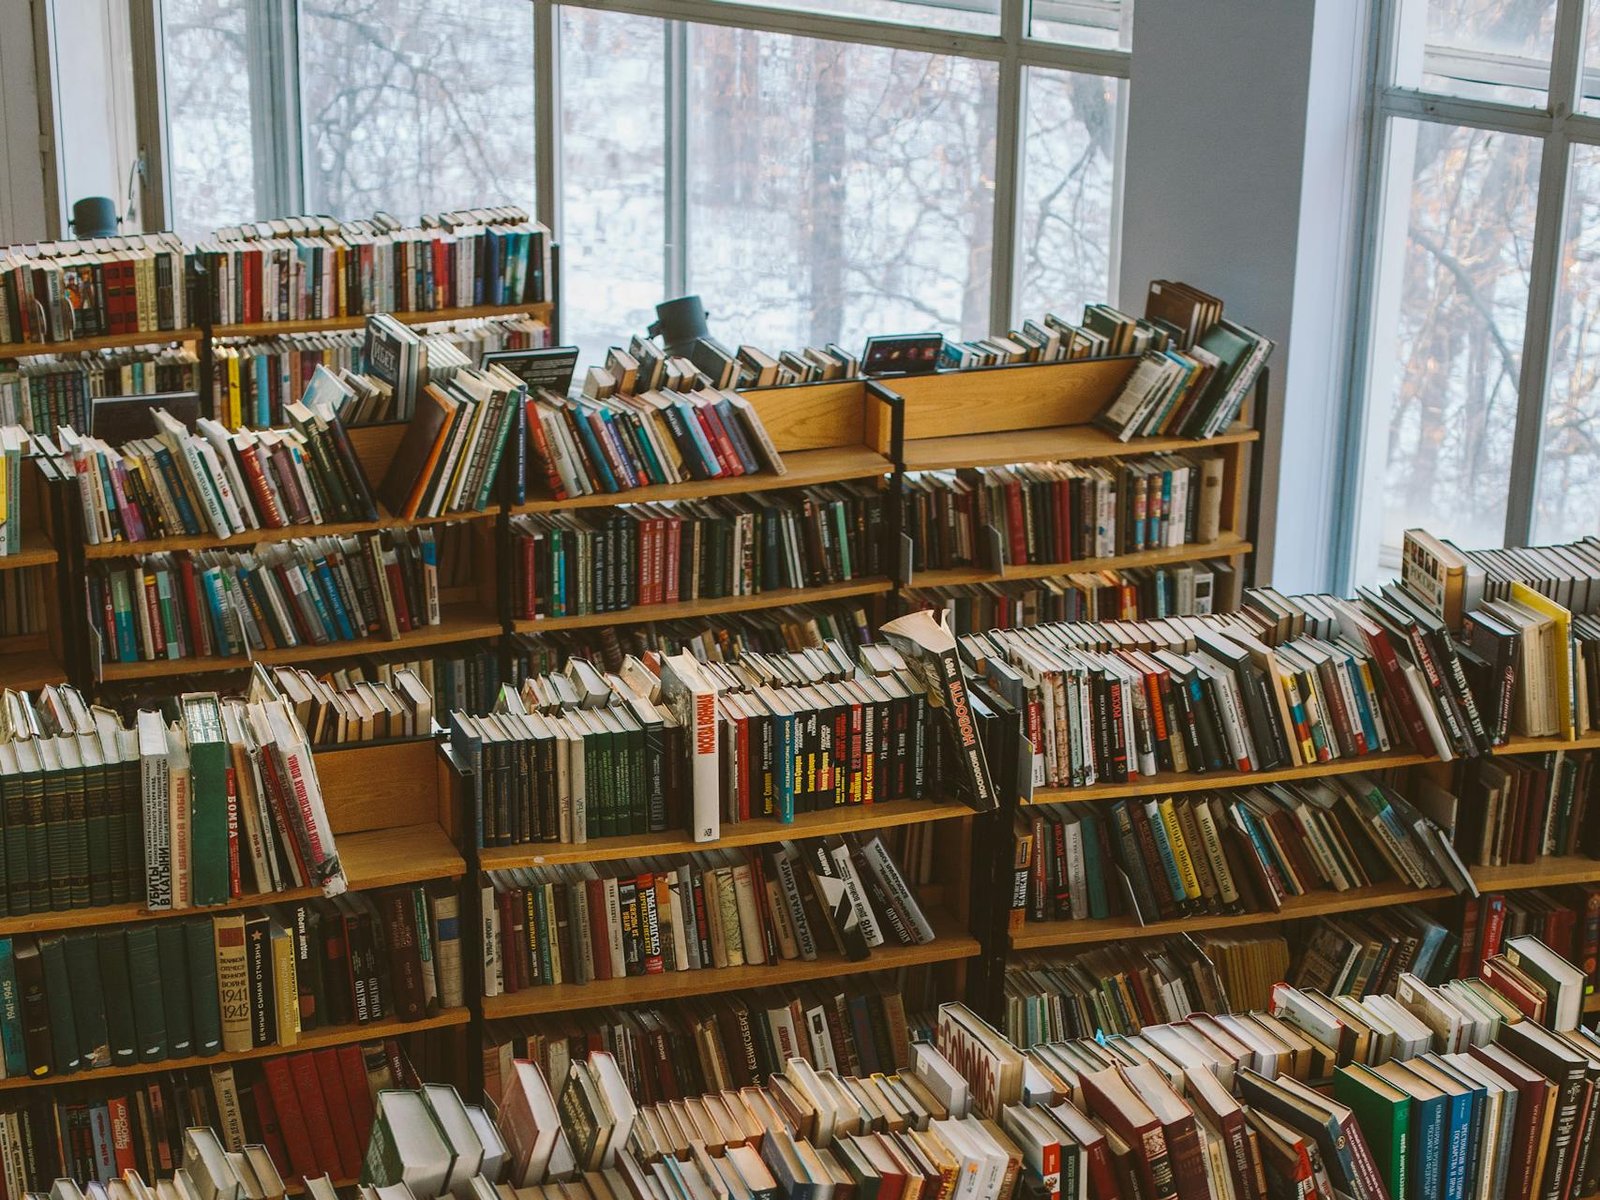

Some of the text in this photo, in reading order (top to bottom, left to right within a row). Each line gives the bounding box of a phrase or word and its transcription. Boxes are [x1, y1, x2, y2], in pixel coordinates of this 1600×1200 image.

[697, 694, 715, 754] МОСКВА ВОЕННАЯ
[944, 657, 988, 799] МОСКОВСКИЕ НОВОСТИ 1989
[288, 754, 303, 777] ВОЙНА
[177, 777, 185, 819] ПОБЕДЫ
[227, 796, 238, 838] БОМБА
[178, 823, 187, 870] ВЕЛИКОЙ
[817, 848, 833, 875] ПАМЯТЬ
[1167, 811, 1195, 888] ИСТОРИЯ СИБИРИ
[1202, 817, 1231, 893] ИСТОРИЯ СИБИРИ
[148, 866, 160, 907] УБИТЫ
[159, 847, 170, 895] КАТЫНИ
[297, 907, 306, 933] НАРОДА
[640, 892, 652, 954] НЕИЗВЕСТНЫЙ
[645, 888, 660, 955] СТАЛИНГРАД
[781, 857, 814, 954] БЛОКАДНАЯ КНИГА
[857, 902, 867, 918] ДНЕЙ
[861, 920, 876, 940] 1418
[4, 981, 15, 1020] 1941-1945
[221, 988, 248, 1002] 1941
[254, 943, 267, 1041] ВЕЧНЫМ СЫНАМ ОТЧИЗНЫ
[355, 981, 365, 993] КТО
[223, 1002, 249, 1018] 1945
[357, 1008, 368, 1020] КТО
